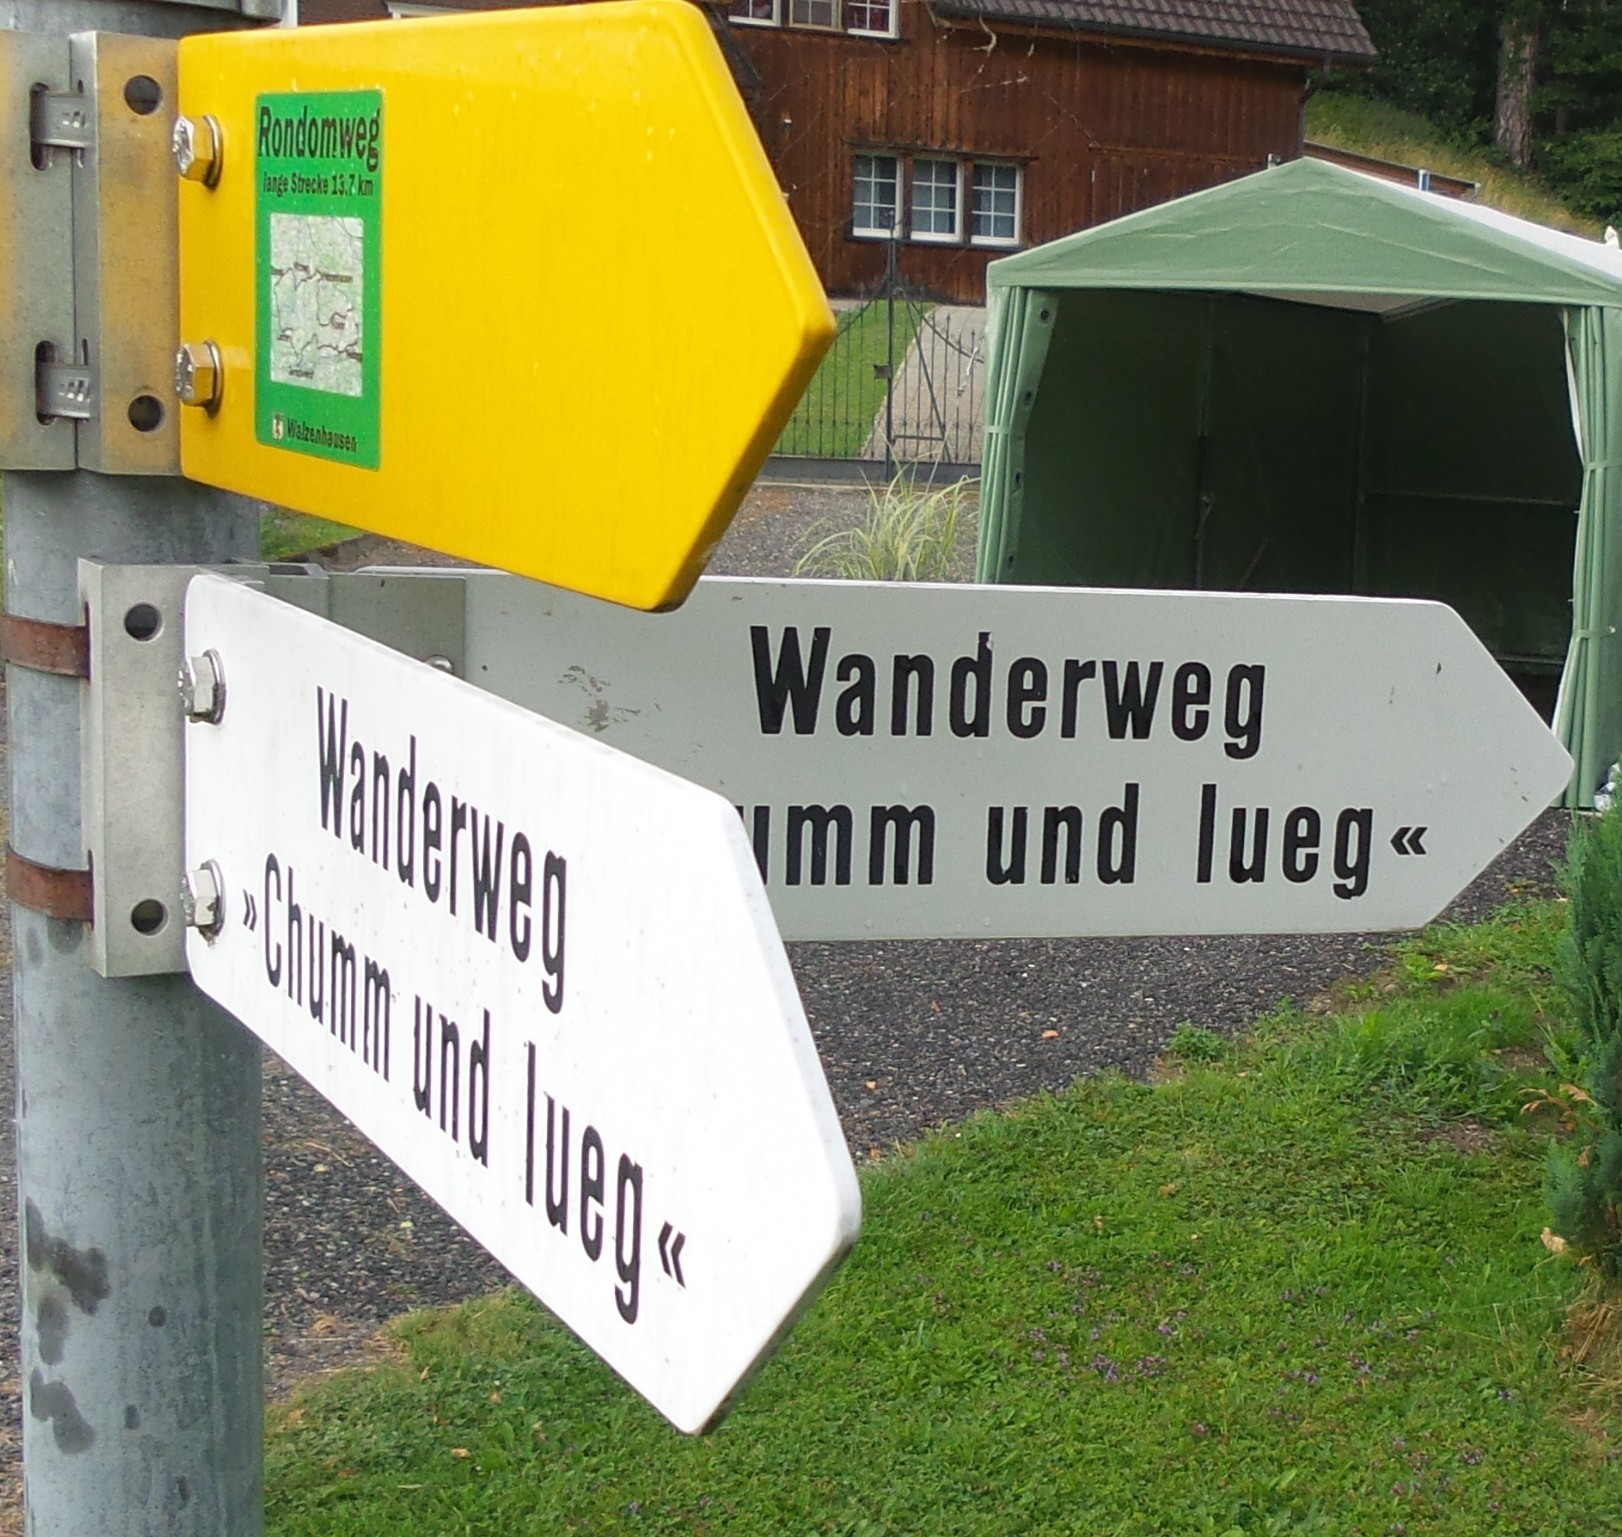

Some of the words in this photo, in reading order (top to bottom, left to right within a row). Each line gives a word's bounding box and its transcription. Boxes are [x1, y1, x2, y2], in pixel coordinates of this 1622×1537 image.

[258, 105, 381, 172] Rondomweg
[263, 172, 289, 197] lange
[291, 172, 329, 195] Strecke
[358, 174, 374, 196] km
[287, 418, 358, 452] Walzenhausen
[750, 625, 1266, 760] Wanderweg
[316, 684, 568, 1015] Wanderweg
[986, 783, 1139, 886] und
[413, 994, 491, 1168] und
